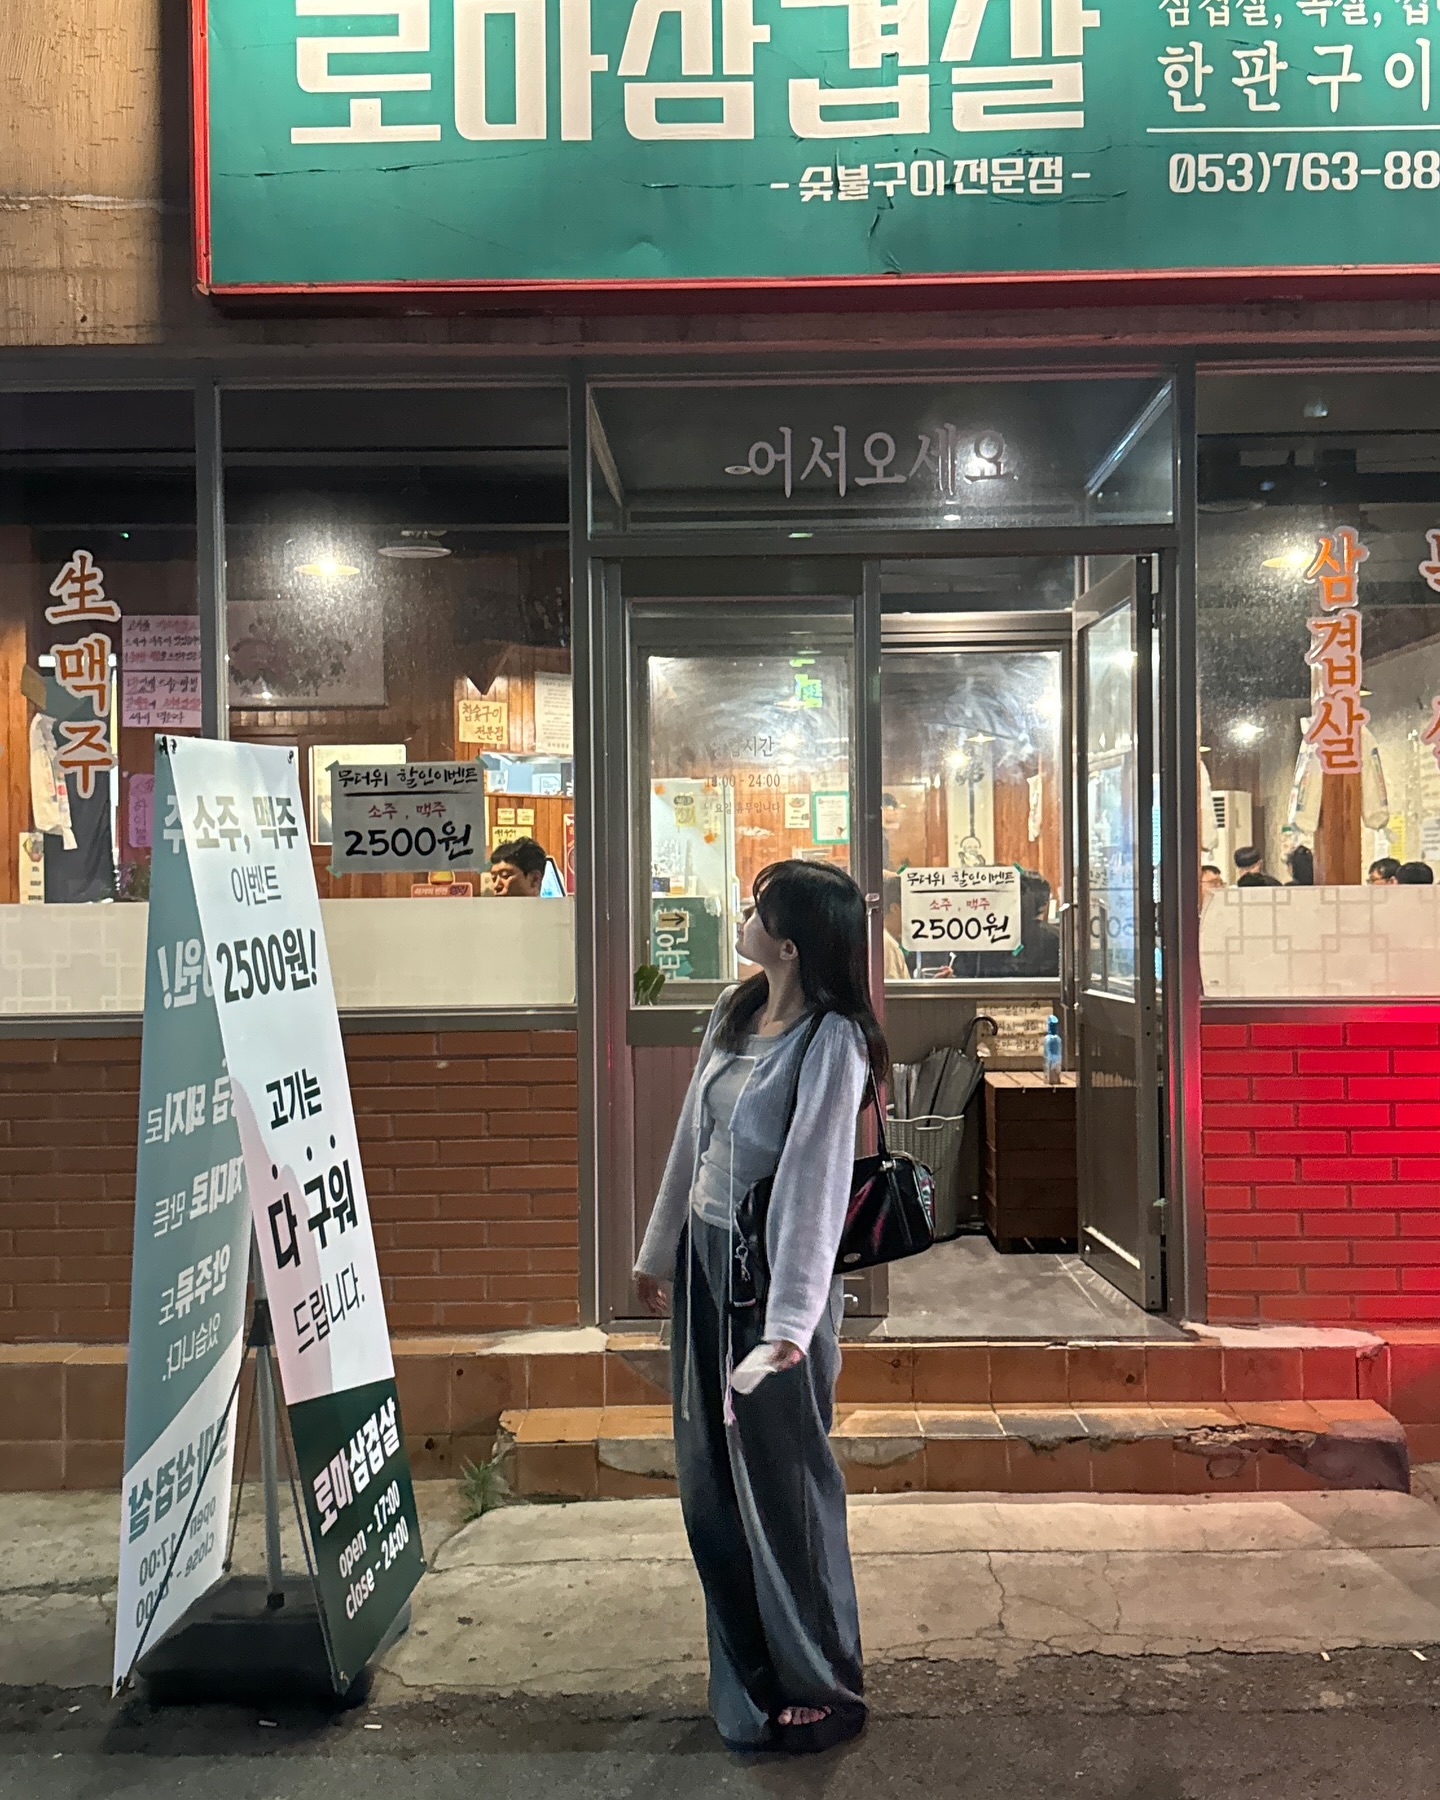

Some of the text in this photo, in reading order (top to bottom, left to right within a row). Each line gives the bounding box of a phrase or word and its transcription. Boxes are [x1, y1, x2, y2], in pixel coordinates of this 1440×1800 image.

[291, 0, 1101, 144] 로마삼겹살
[749, 422, 1010, 499] 어서오세요
[1306, 527, 1369, 774] 삼겹살
[462, 703, 502, 723] 참숯구이
[475, 725, 503, 741] 전문점
[338, 769, 388, 787] 무더위
[749, 773, 780, 787] 24:00
[252, 797, 298, 849] 맥주
[416, 802, 446, 819] 맥주
[344, 820, 474, 861] 2500원
[230, 866, 281, 906] 이벤트
[907, 872, 945, 886] 무더위
[966, 897, 990, 911] 맥주
[911, 912, 1011, 944] 2500원
[216, 928, 317, 1003] 2500원!
[266, 1069, 322, 1130] 고기는
[268, 1160, 358, 1269] 다 구워
[292, 1263, 366, 1354] 드립니다.
[313, 1397, 400, 1536] 로마삼겹살
[339, 1529, 367, 1578] open
[373, 1480, 400, 1532] 17:00
[346, 1566, 375, 1620] close
[381, 1515, 409, 1571] 24:00
